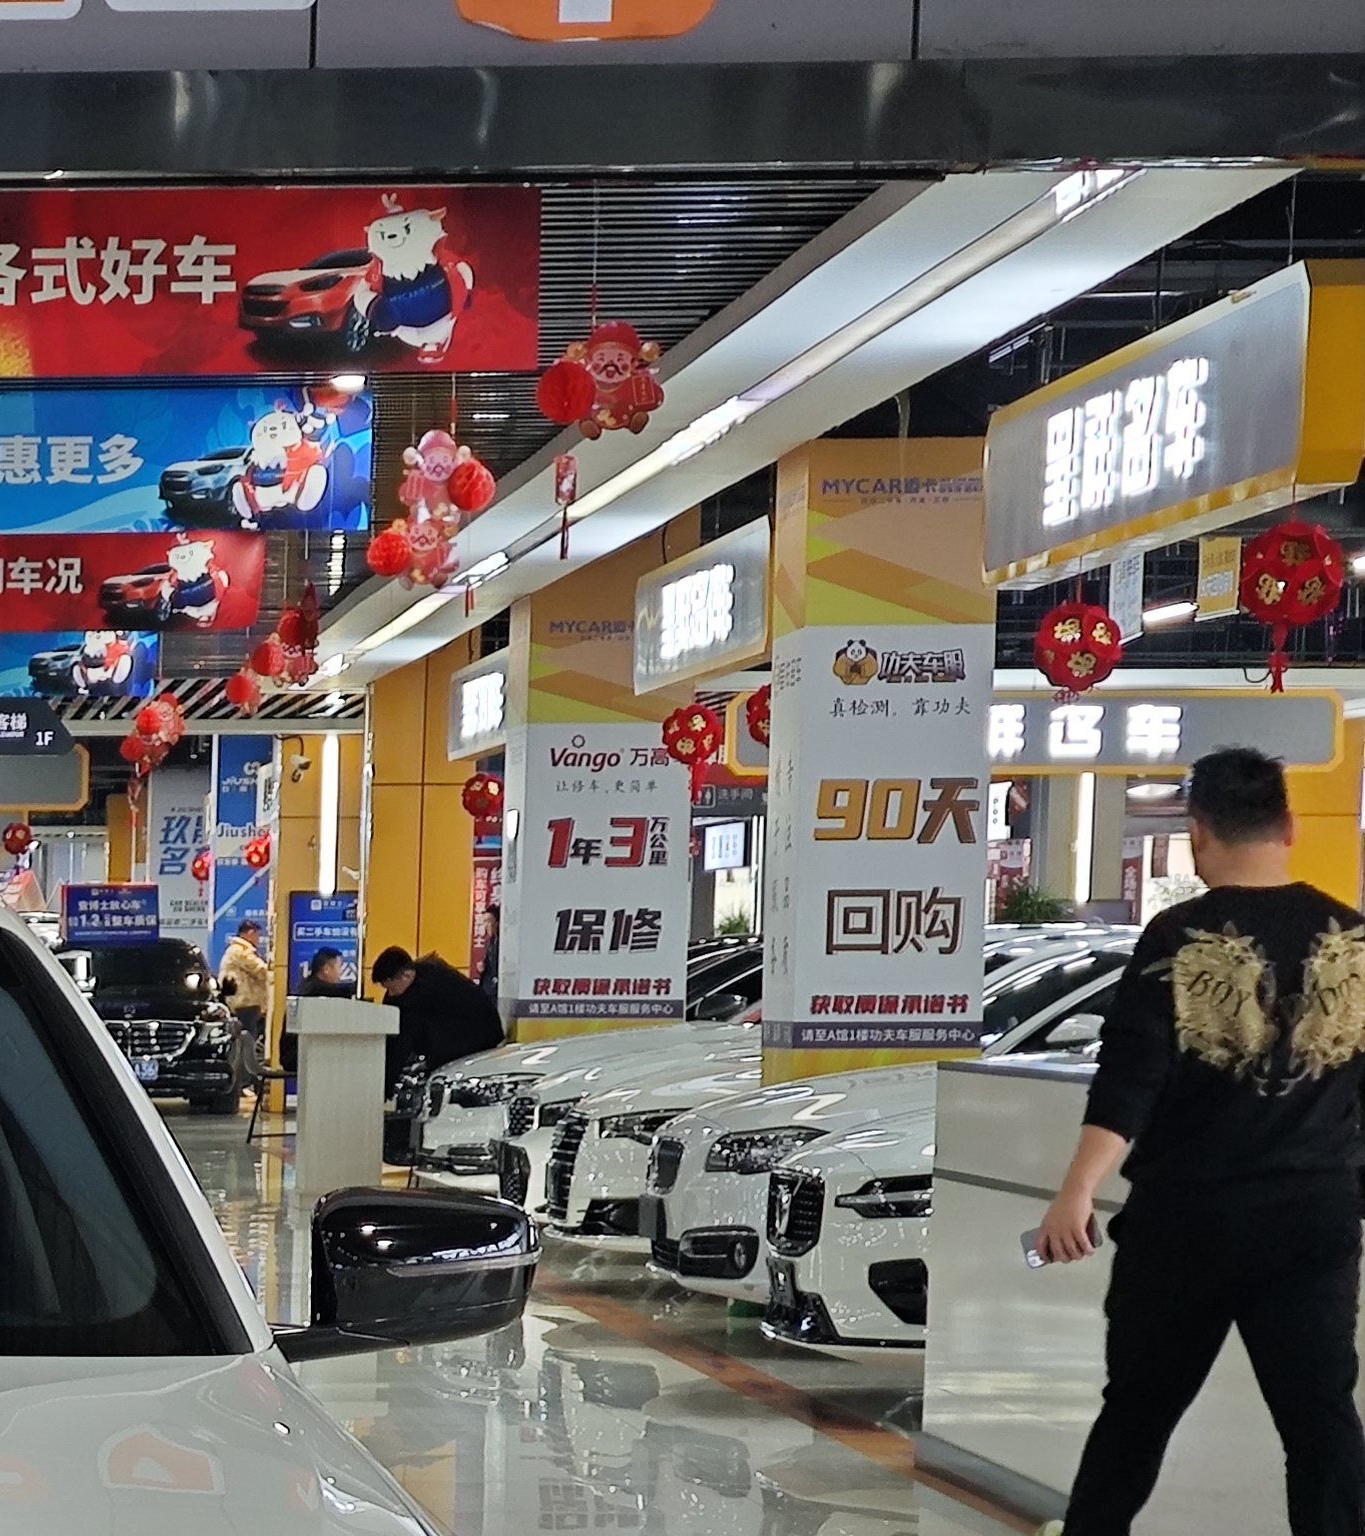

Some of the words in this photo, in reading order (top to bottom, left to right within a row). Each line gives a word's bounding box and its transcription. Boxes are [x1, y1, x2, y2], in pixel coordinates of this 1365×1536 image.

[822, 478, 901, 494] MYCAR
[35, 731, 54, 747] 1F
[549, 747, 621, 773] Vango
[813, 776, 980, 844] 90天
[553, 908, 663, 955] 保修
[824, 886, 966, 957] 回购
